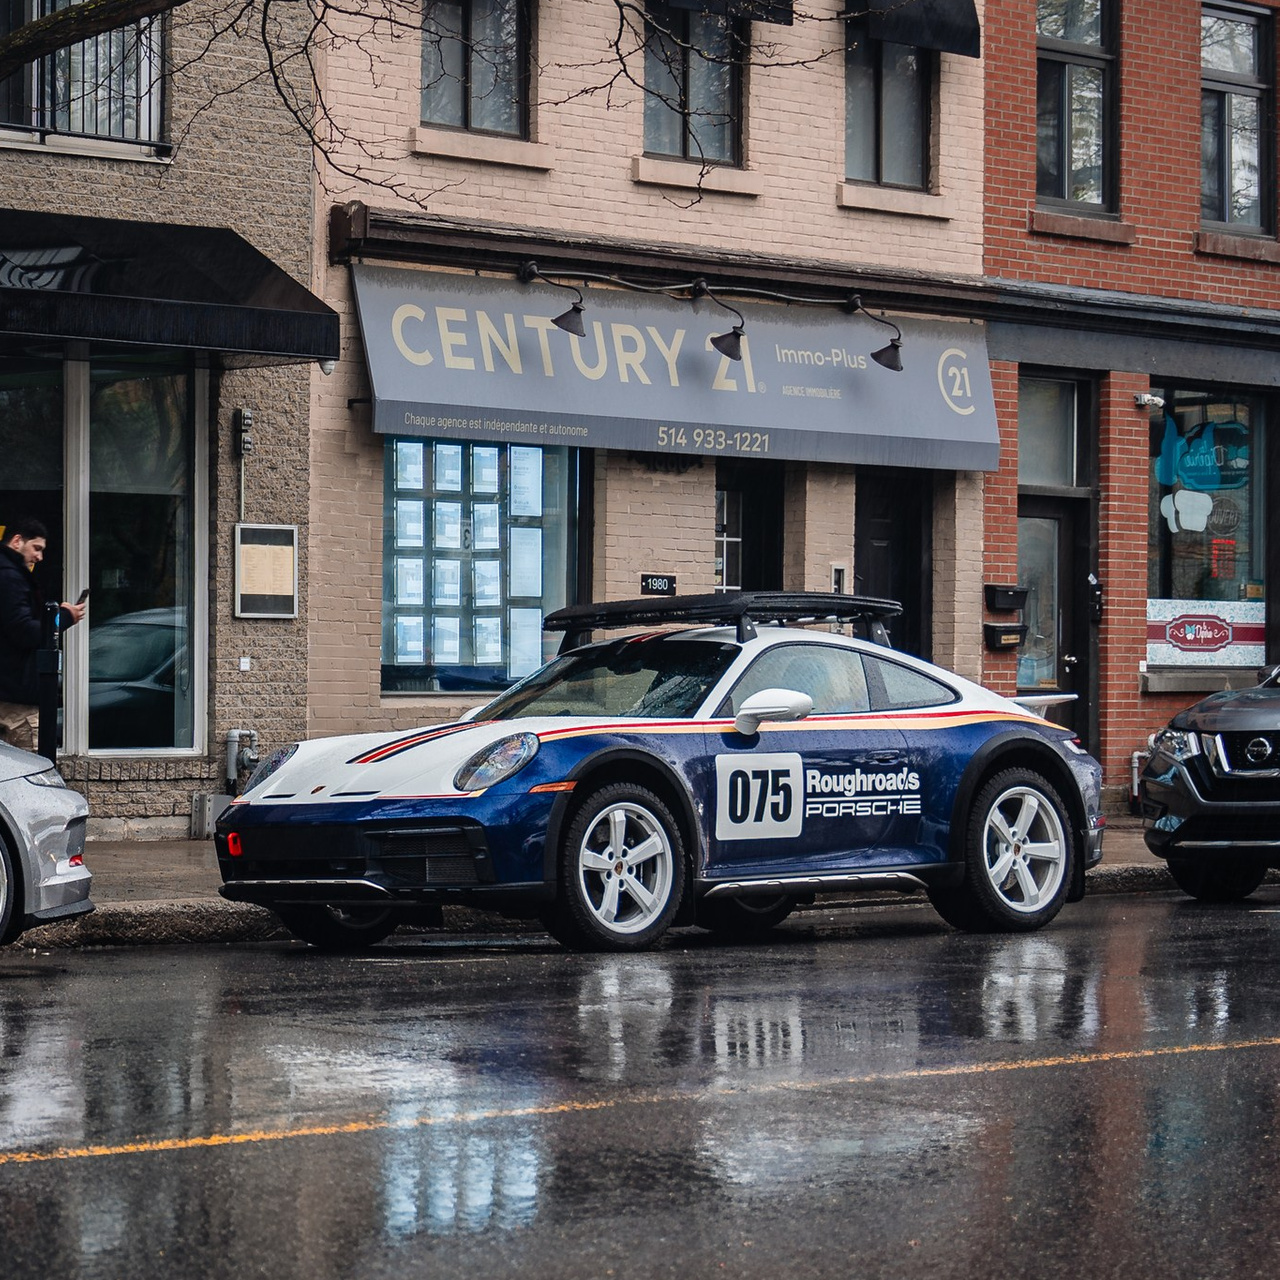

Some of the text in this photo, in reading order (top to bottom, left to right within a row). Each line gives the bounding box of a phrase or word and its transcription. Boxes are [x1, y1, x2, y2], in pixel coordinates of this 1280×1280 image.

[391, 303, 686, 387] CENTURY
[775, 344, 867, 369] Immo-Plus
[404, 412, 588, 437] Chaque agence est indépendante et autonome
[657, 426, 770, 452] 514 933-1221
[647, 578, 669, 590] 1980
[806, 767, 920, 797] Roughroads
[728, 769, 792, 824] 075
[806, 800, 921, 818] PORSCHE
